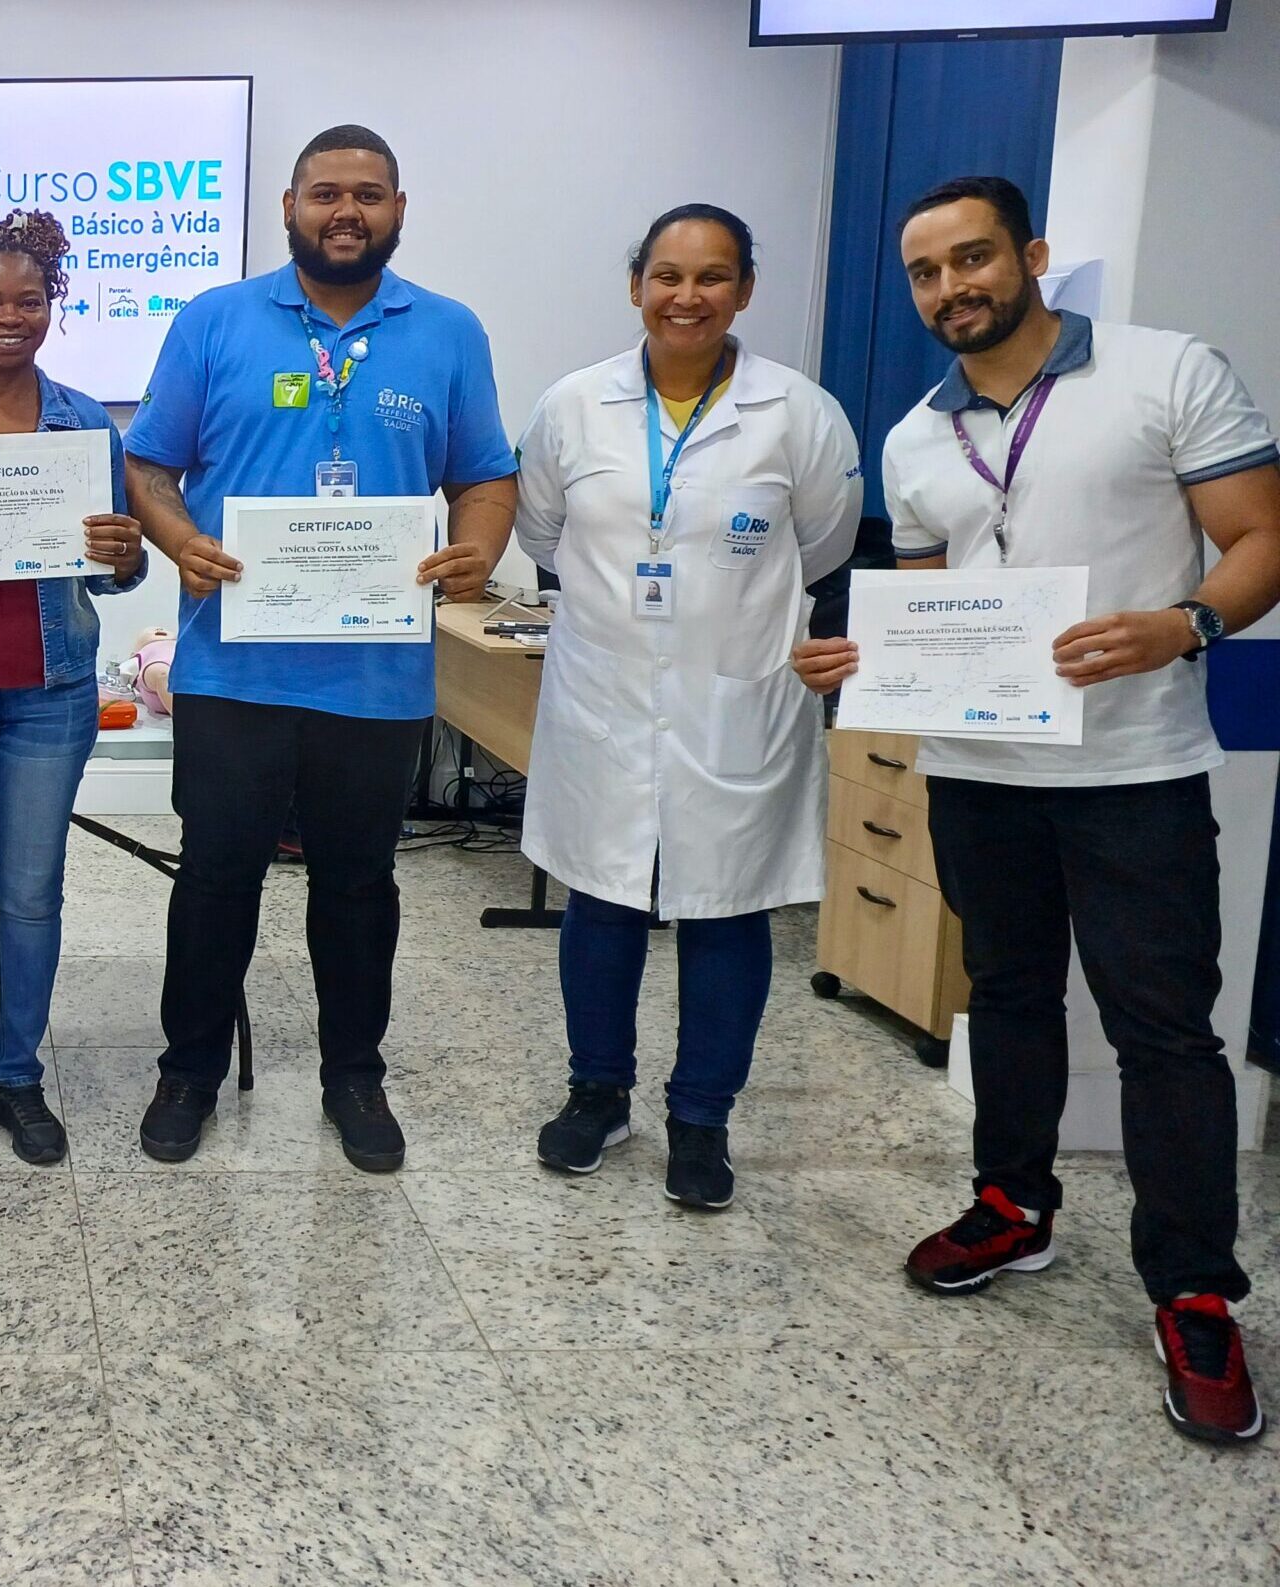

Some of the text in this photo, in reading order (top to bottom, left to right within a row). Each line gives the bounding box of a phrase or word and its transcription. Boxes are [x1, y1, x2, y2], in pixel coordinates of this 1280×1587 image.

[106, 160, 223, 202] SBVE
[71, 211, 221, 236] Básico à Vida
[87, 244, 220, 273] Emergência
[397, 394, 423, 413] Rio
[288, 520, 373, 533] CERTIFICADO
[749, 518, 770, 533] Rio
[279, 544, 380, 553] VINÍCIUS COSTA SANTOS
[26, 561, 42, 569] Rio
[907, 598, 1003, 613] CERTIFICADO
[352, 615, 370, 625] Rio
[886, 628, 915, 636] THIAGO
[951, 625, 996, 635] GUIMARÃES
[998, 625, 1024, 633] SOUZA
[977, 710, 998, 721] Rio
